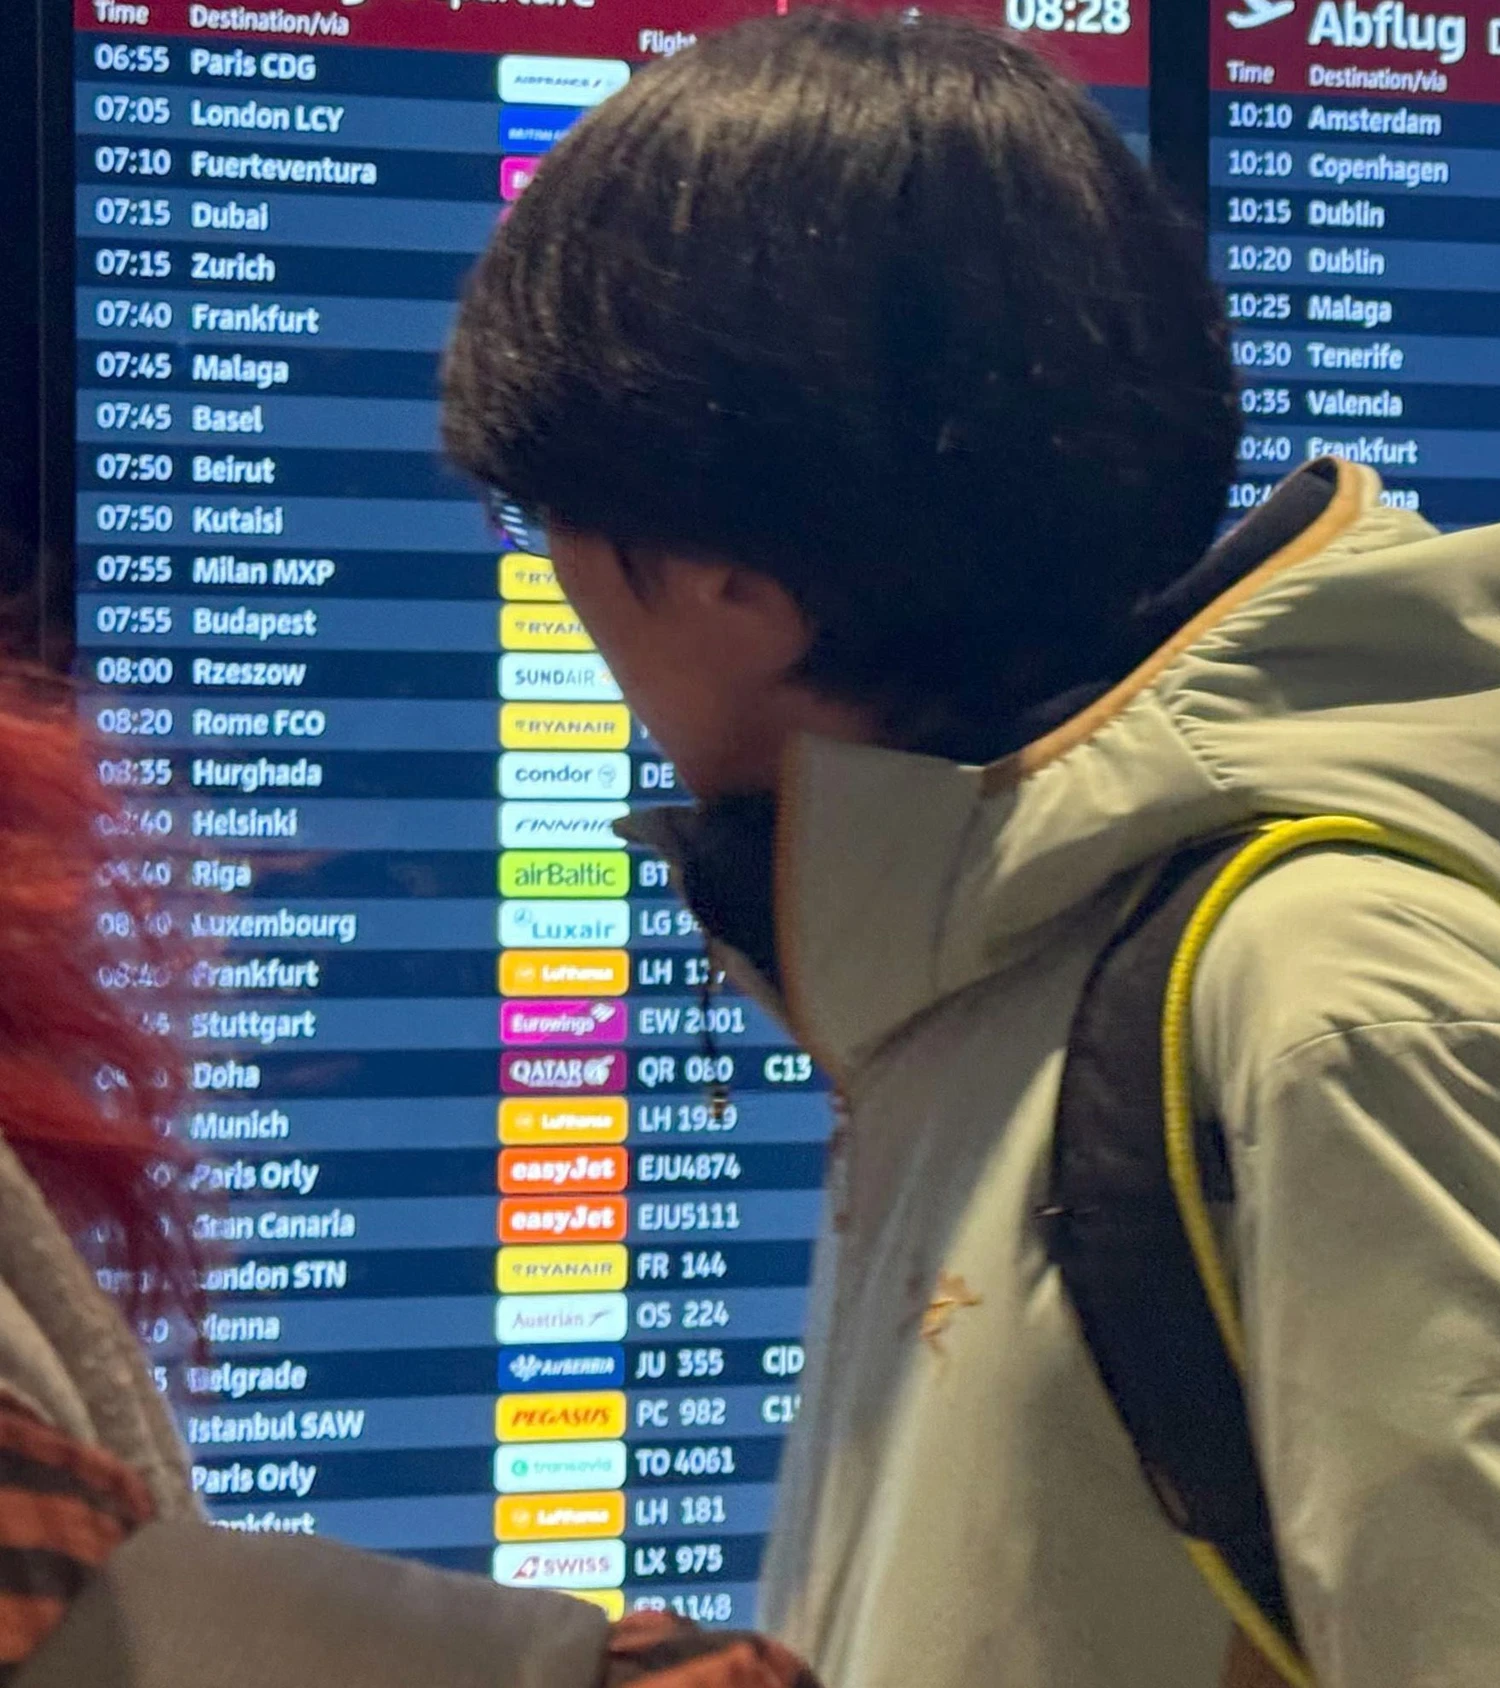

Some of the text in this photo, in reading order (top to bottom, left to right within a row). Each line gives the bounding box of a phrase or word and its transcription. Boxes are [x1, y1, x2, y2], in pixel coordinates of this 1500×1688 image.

[189, 4, 350, 36] Destination/via
[1006, 0, 1131, 33] 08:28
[1308, 0, 1466, 64] Abflug
[94, 43, 317, 81] 06:55 Paris CDG
[1226, 60, 1275, 85] Time
[1309, 63, 1448, 93] Destination/via
[95, 95, 345, 133] 07:05 London LCY
[1228, 101, 1293, 129] 10:10
[1307, 105, 1442, 136] Amsterdam
[95, 146, 377, 185] 07:10 Fuerteventura
[1229, 149, 1293, 177] 10:10
[1308, 152, 1449, 188] Copenhagen
[95, 197, 268, 231] 07:15 Dubai
[1228, 197, 1292, 224] 10:15
[1308, 199, 1385, 228] Dublin
[95, 248, 276, 282] 07:15 Zurich
[1228, 245, 1292, 272] 10:20
[1308, 247, 1385, 275] Dublin
[96, 299, 320, 334] 07:40 Frankfurt
[1228, 292, 1291, 319] 10:25
[1307, 294, 1393, 329] Malaga
[96, 350, 289, 390] 07:45 Malaga
[96, 402, 264, 433] 07:45 Basel
[96, 452, 276, 484] 07:50 Beirut
[96, 504, 283, 535] 07:50 Kutaisi
[96, 555, 335, 586] 07:55 Milan MXP
[97, 606, 317, 641] 07:55 Budapest
[96, 656, 595, 687] 08:00 Rzeszow SUNDAIR
[96, 707, 617, 736] 08:20 Rome FCO RYANAIR
[192, 757, 675, 793] Hurghada condor DE
[514, 862, 617, 887] airBaltic
[531, 919, 616, 940] Luxair
[510, 1007, 681, 1036] Eurowings EW
[509, 1053, 812, 1088] QATAR QR C13
[510, 1152, 741, 1184] easyJet EJU4874
[509, 1201, 740, 1235] easyJet EJU5111
[525, 1251, 727, 1280] RYANAIR FR 144
[512, 1299, 730, 1329] Austrian OS 224
[300, 1397, 726, 1440] SAW PEGASUS PC 982
[256, 1445, 736, 1497] Orly TO 4061
[543, 1543, 724, 1576] SWISS LX 975
